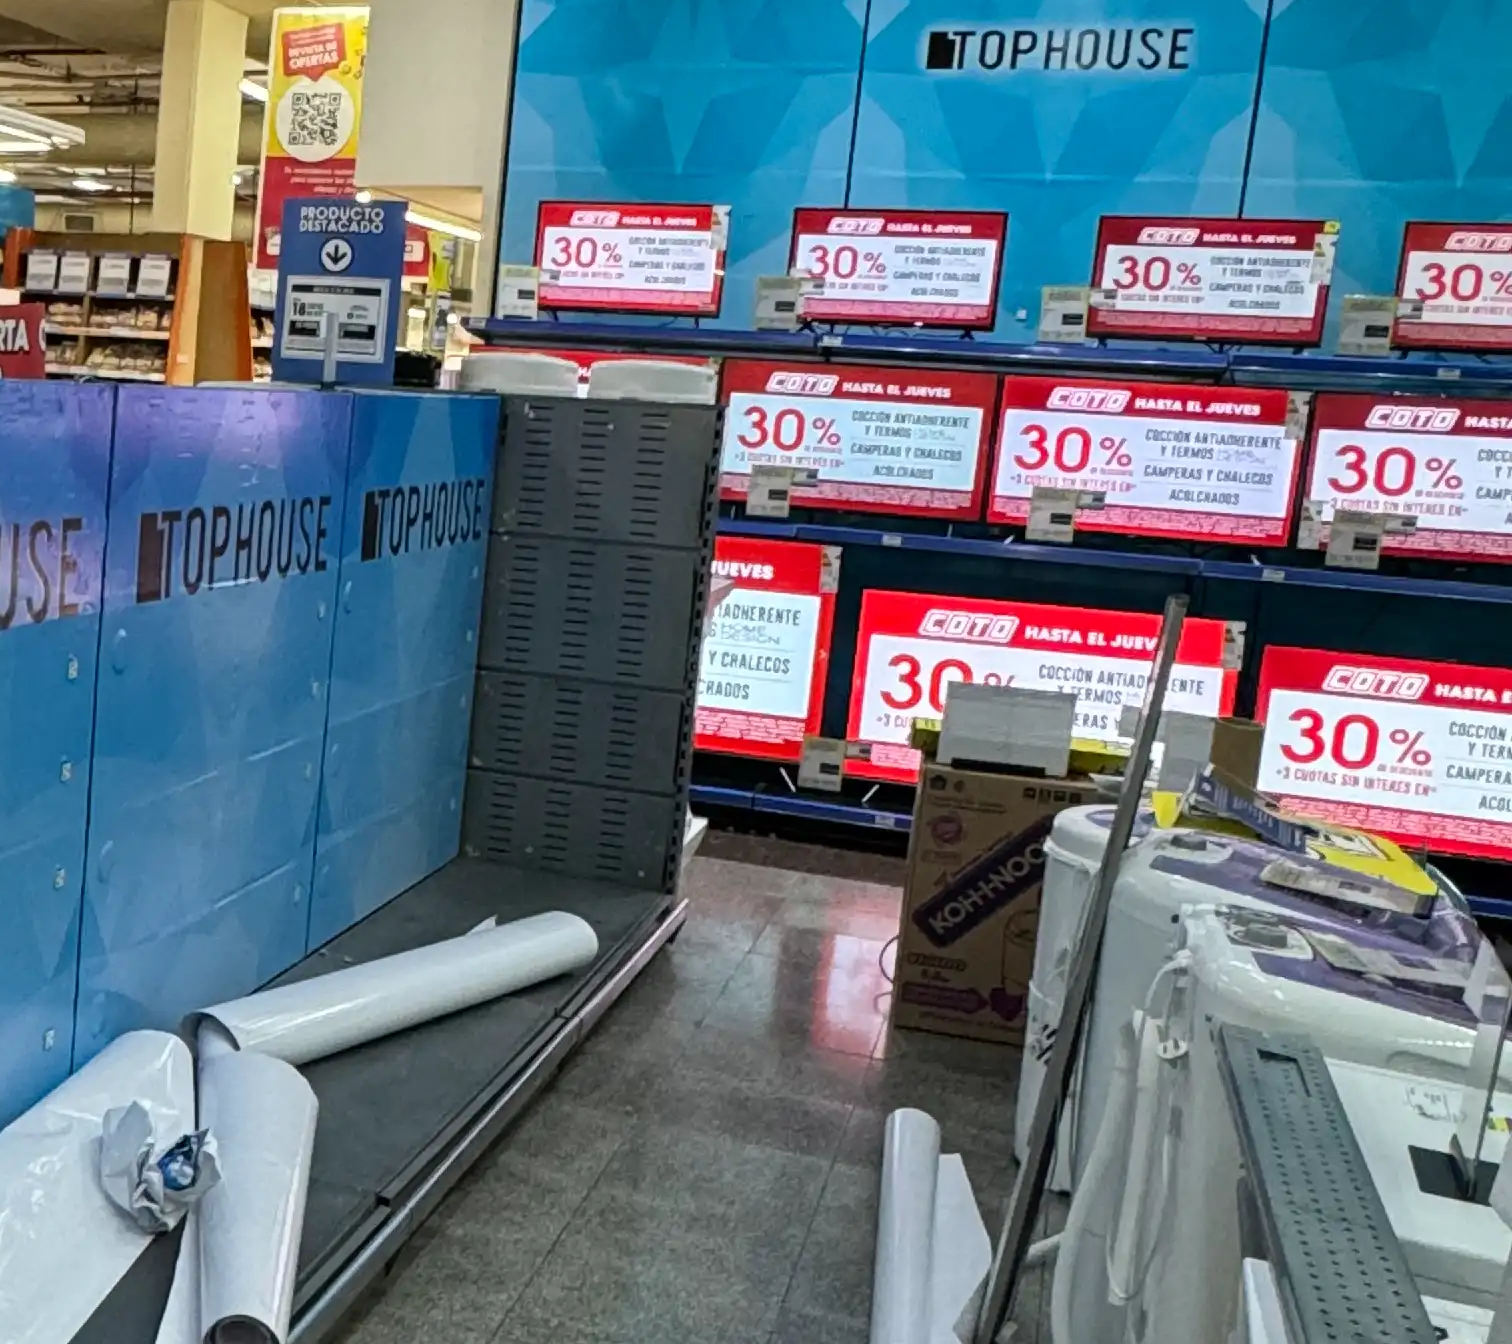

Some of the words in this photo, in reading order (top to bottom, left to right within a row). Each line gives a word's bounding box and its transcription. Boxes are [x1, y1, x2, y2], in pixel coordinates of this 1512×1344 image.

[948, 27, 1195, 71] TOPHOUSE
[299, 206, 385, 222] PRODUCTO
[299, 219, 384, 234] DESTACADO
[551, 236, 622, 268] 30%
[808, 244, 887, 279] 30%
[1112, 256, 1202, 291] 30%
[765, 372, 839, 396] COTO
[1047, 386, 1132, 414] COTO
[1135, 398, 1182, 412] HASTA
[737, 405, 842, 452] 30%
[1365, 405, 1461, 432] COTO
[1013, 424, 1133, 474] 30%
[1328, 445, 1464, 497] 30%
[377, 478, 486, 558] TOPHOUSE
[158, 496, 332, 596] TOPHOUSE
[918, 608, 1020, 644] COTO
[1024, 626, 1083, 645] HASTA
[1087, 632, 1108, 647] EL
[1110, 634, 1159, 652] JUEV
[708, 649, 717, 666] Y
[720, 651, 792, 675] CHALECOS
[1097, 670, 1205, 696] ANTIADENTE
[1322, 664, 1430, 700] COTO
[1434, 683, 1496, 703] HASTA
[1279, 708, 1432, 771] 30%
[1449, 720, 1507, 742] COCCIÓN
[928, 841, 1045, 935] KOH-I-NOO
